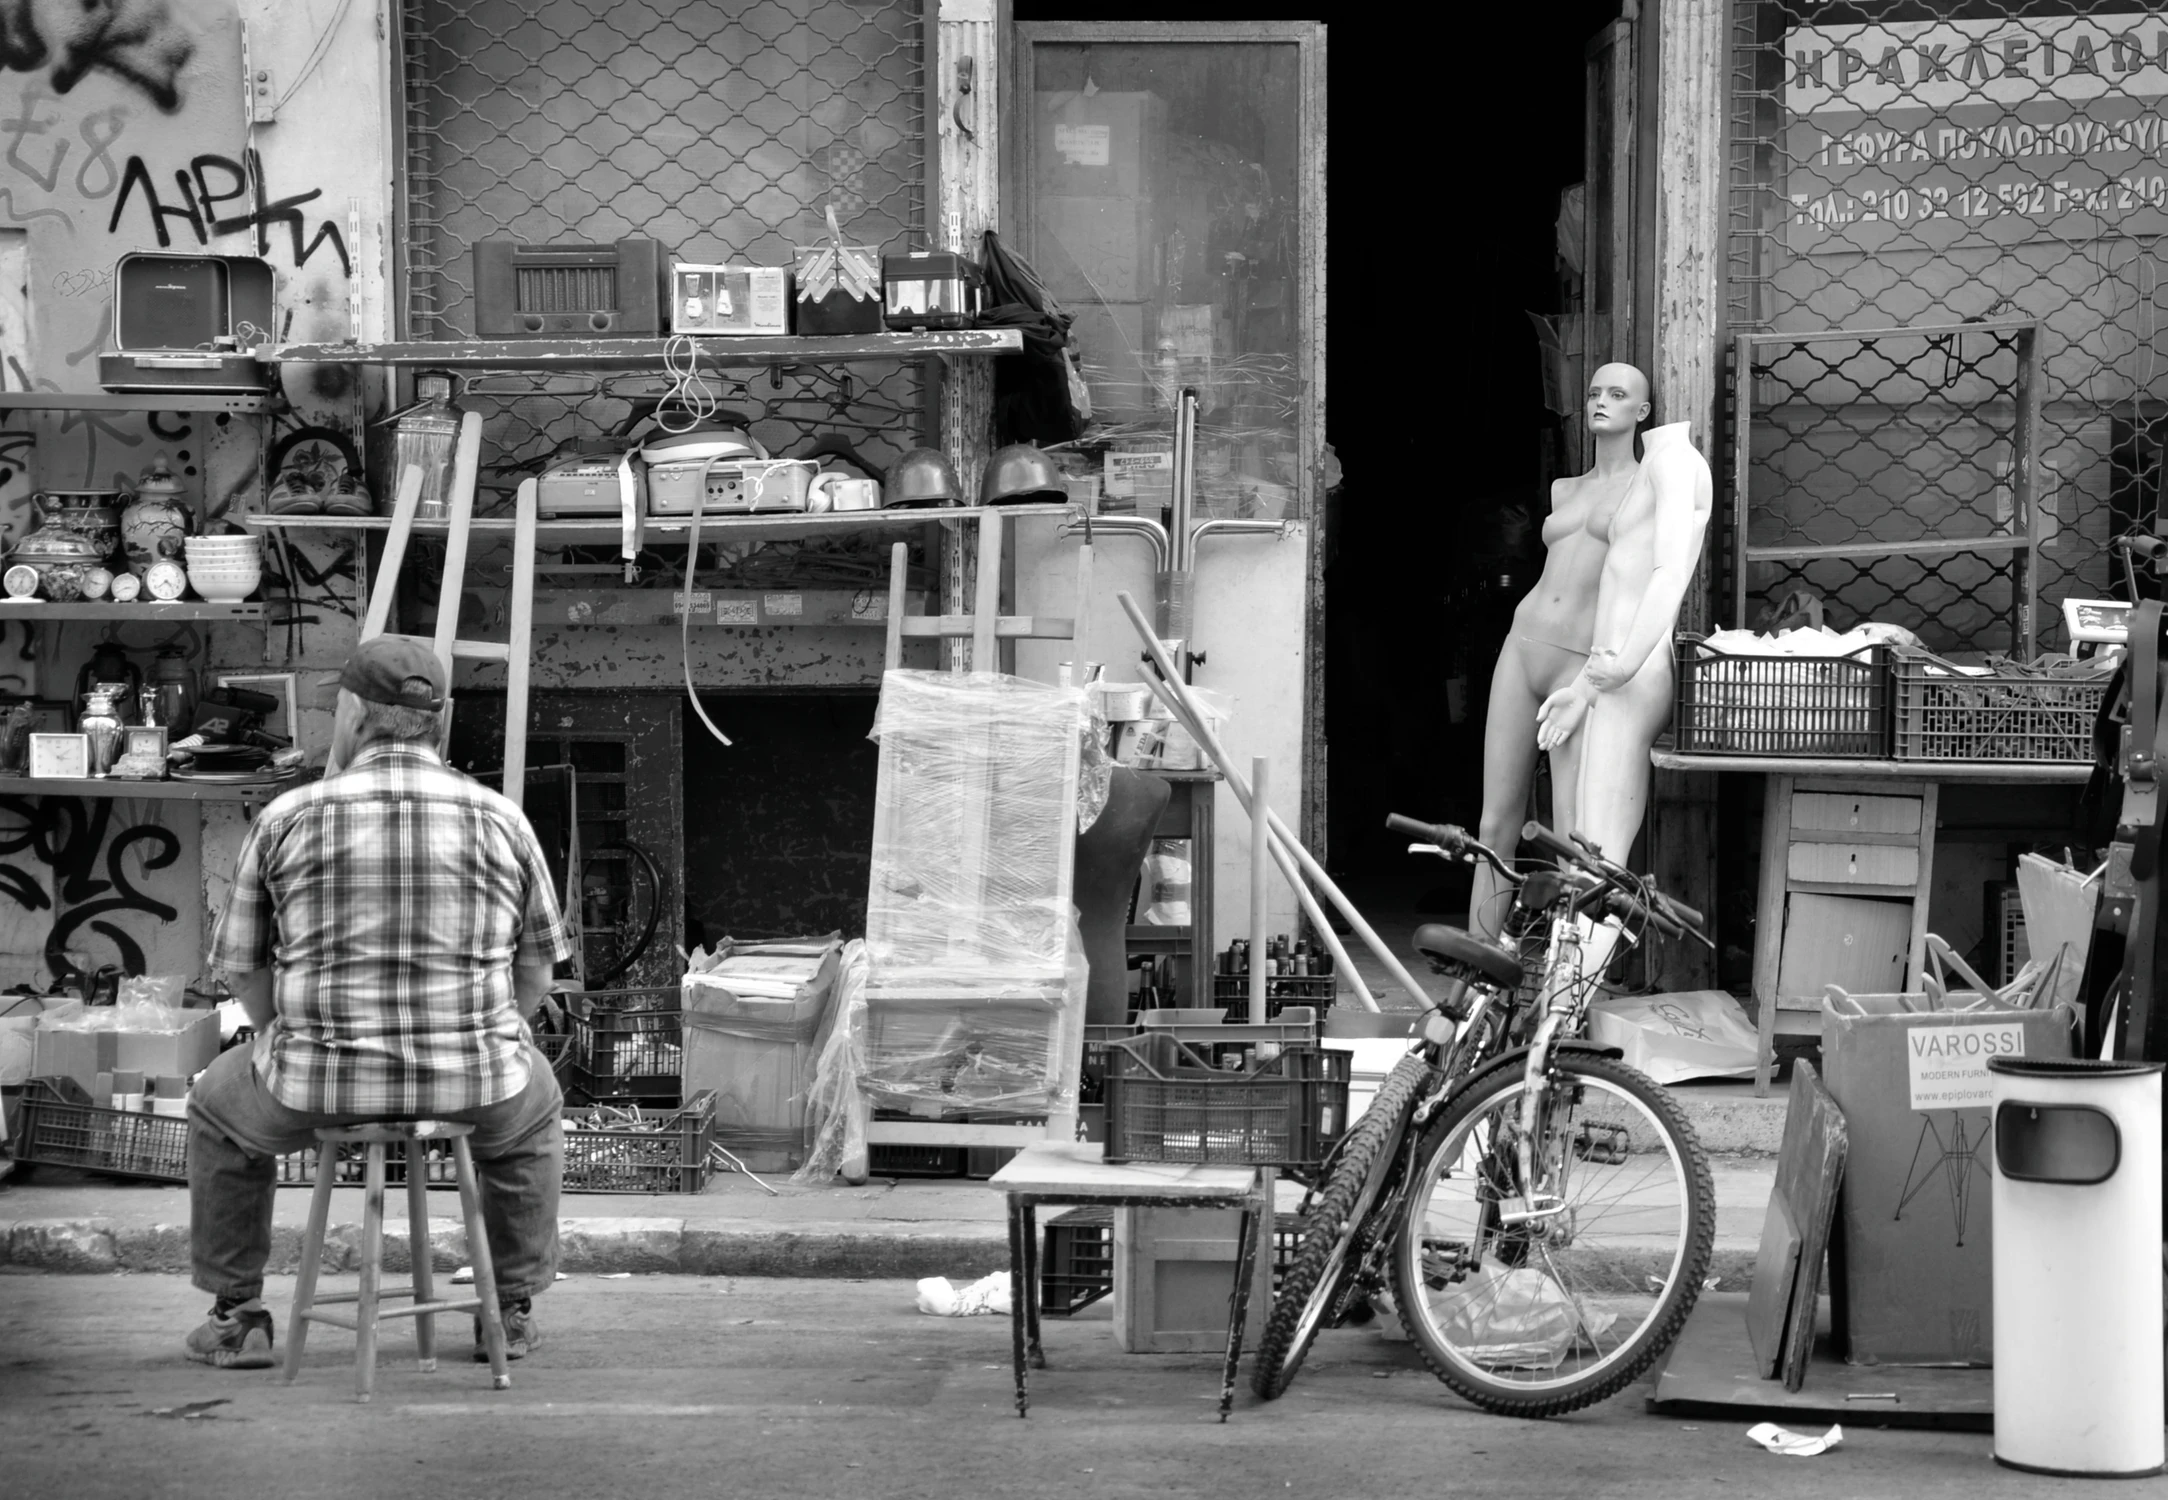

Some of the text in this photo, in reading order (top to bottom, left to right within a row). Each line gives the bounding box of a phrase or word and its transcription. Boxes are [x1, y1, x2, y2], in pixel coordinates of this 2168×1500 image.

[1862, 188, 1910, 222] 210
[1918, 186, 1950, 218] 32
[1958, 185, 1990, 217] 12
[1998, 182, 2046, 216] 592
[2117, 175, 2166, 210] 210
[1911, 1031, 2021, 1057] VAROSSI
[1921, 1070, 1960, 1080] MODERN
